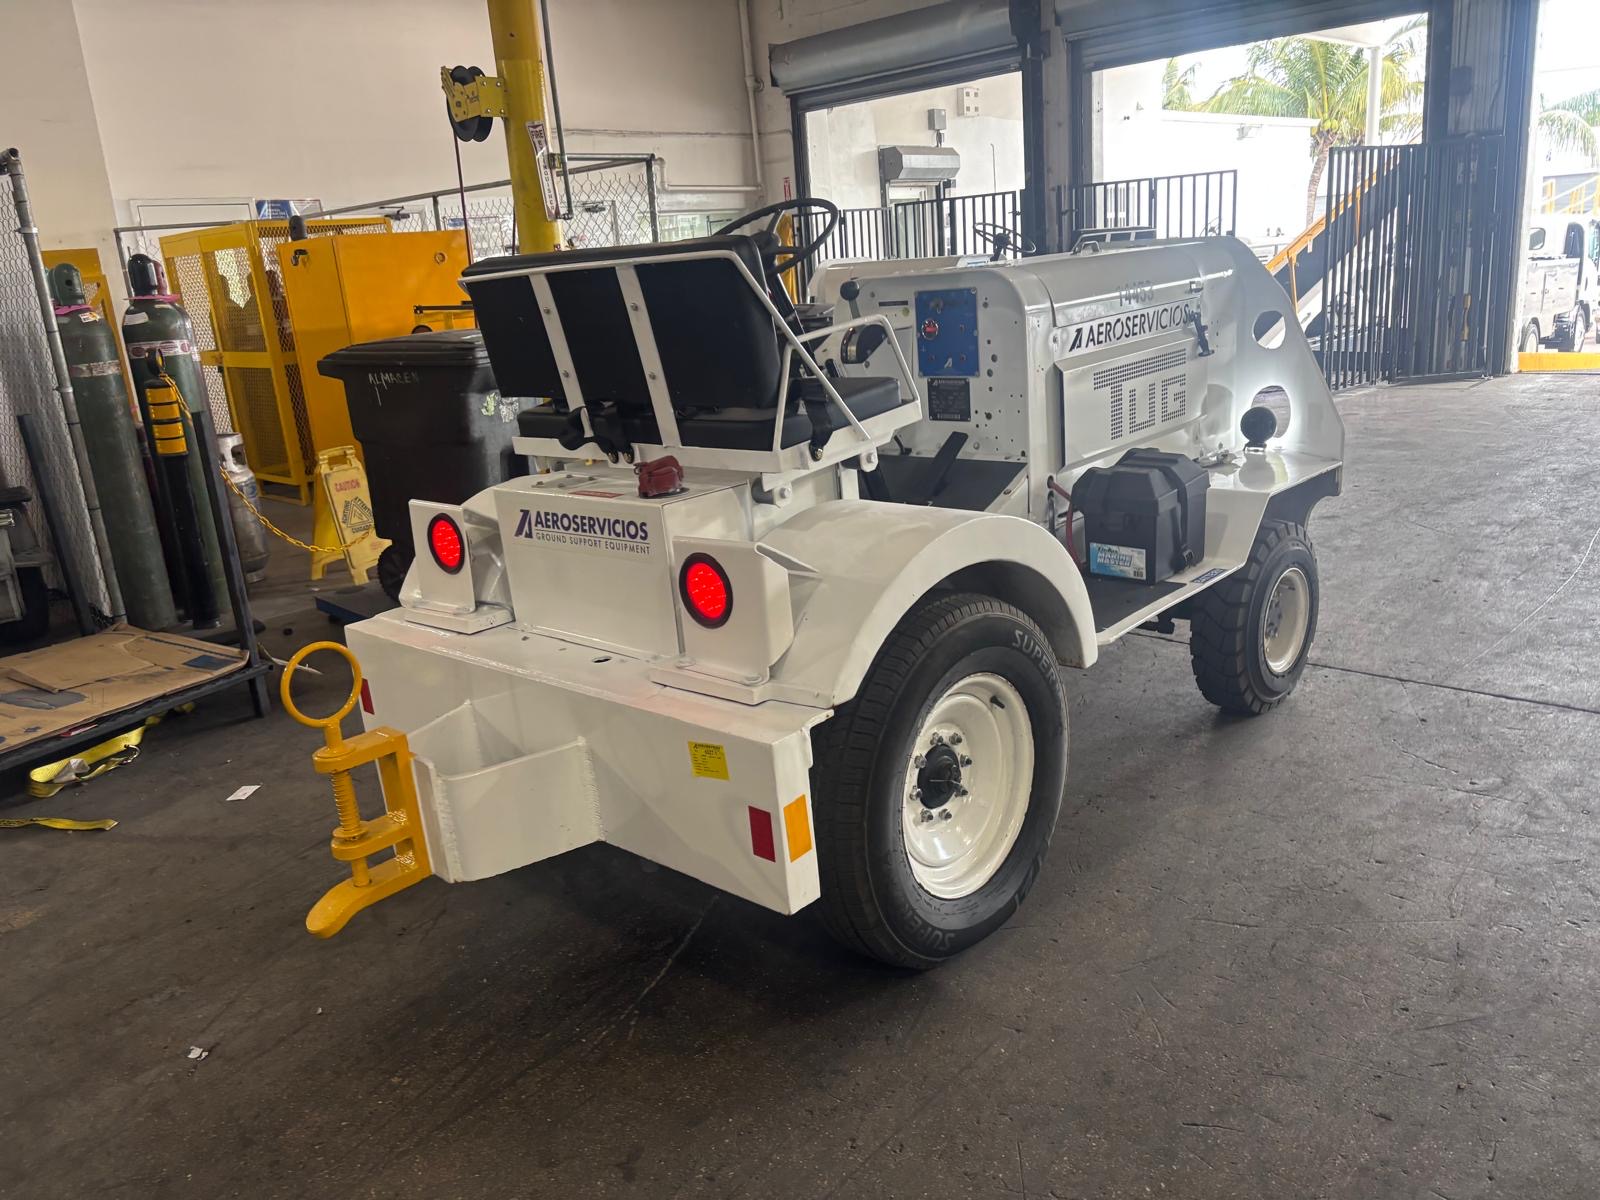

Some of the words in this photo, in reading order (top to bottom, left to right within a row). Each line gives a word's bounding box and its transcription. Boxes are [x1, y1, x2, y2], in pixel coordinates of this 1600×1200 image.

[530, 130, 544, 139] FIRE
[1085, 303, 1190, 348] AEROSERVICIOS
[1093, 348, 1186, 440] TUG
[534, 510, 649, 541] AEROSERVICIOS
[535, 532, 567, 544] GROUND
[569, 536, 601, 549] SUPPORT
[604, 540, 651, 555] EQUIPMENT
[1012, 629, 1056, 685] SUPER
